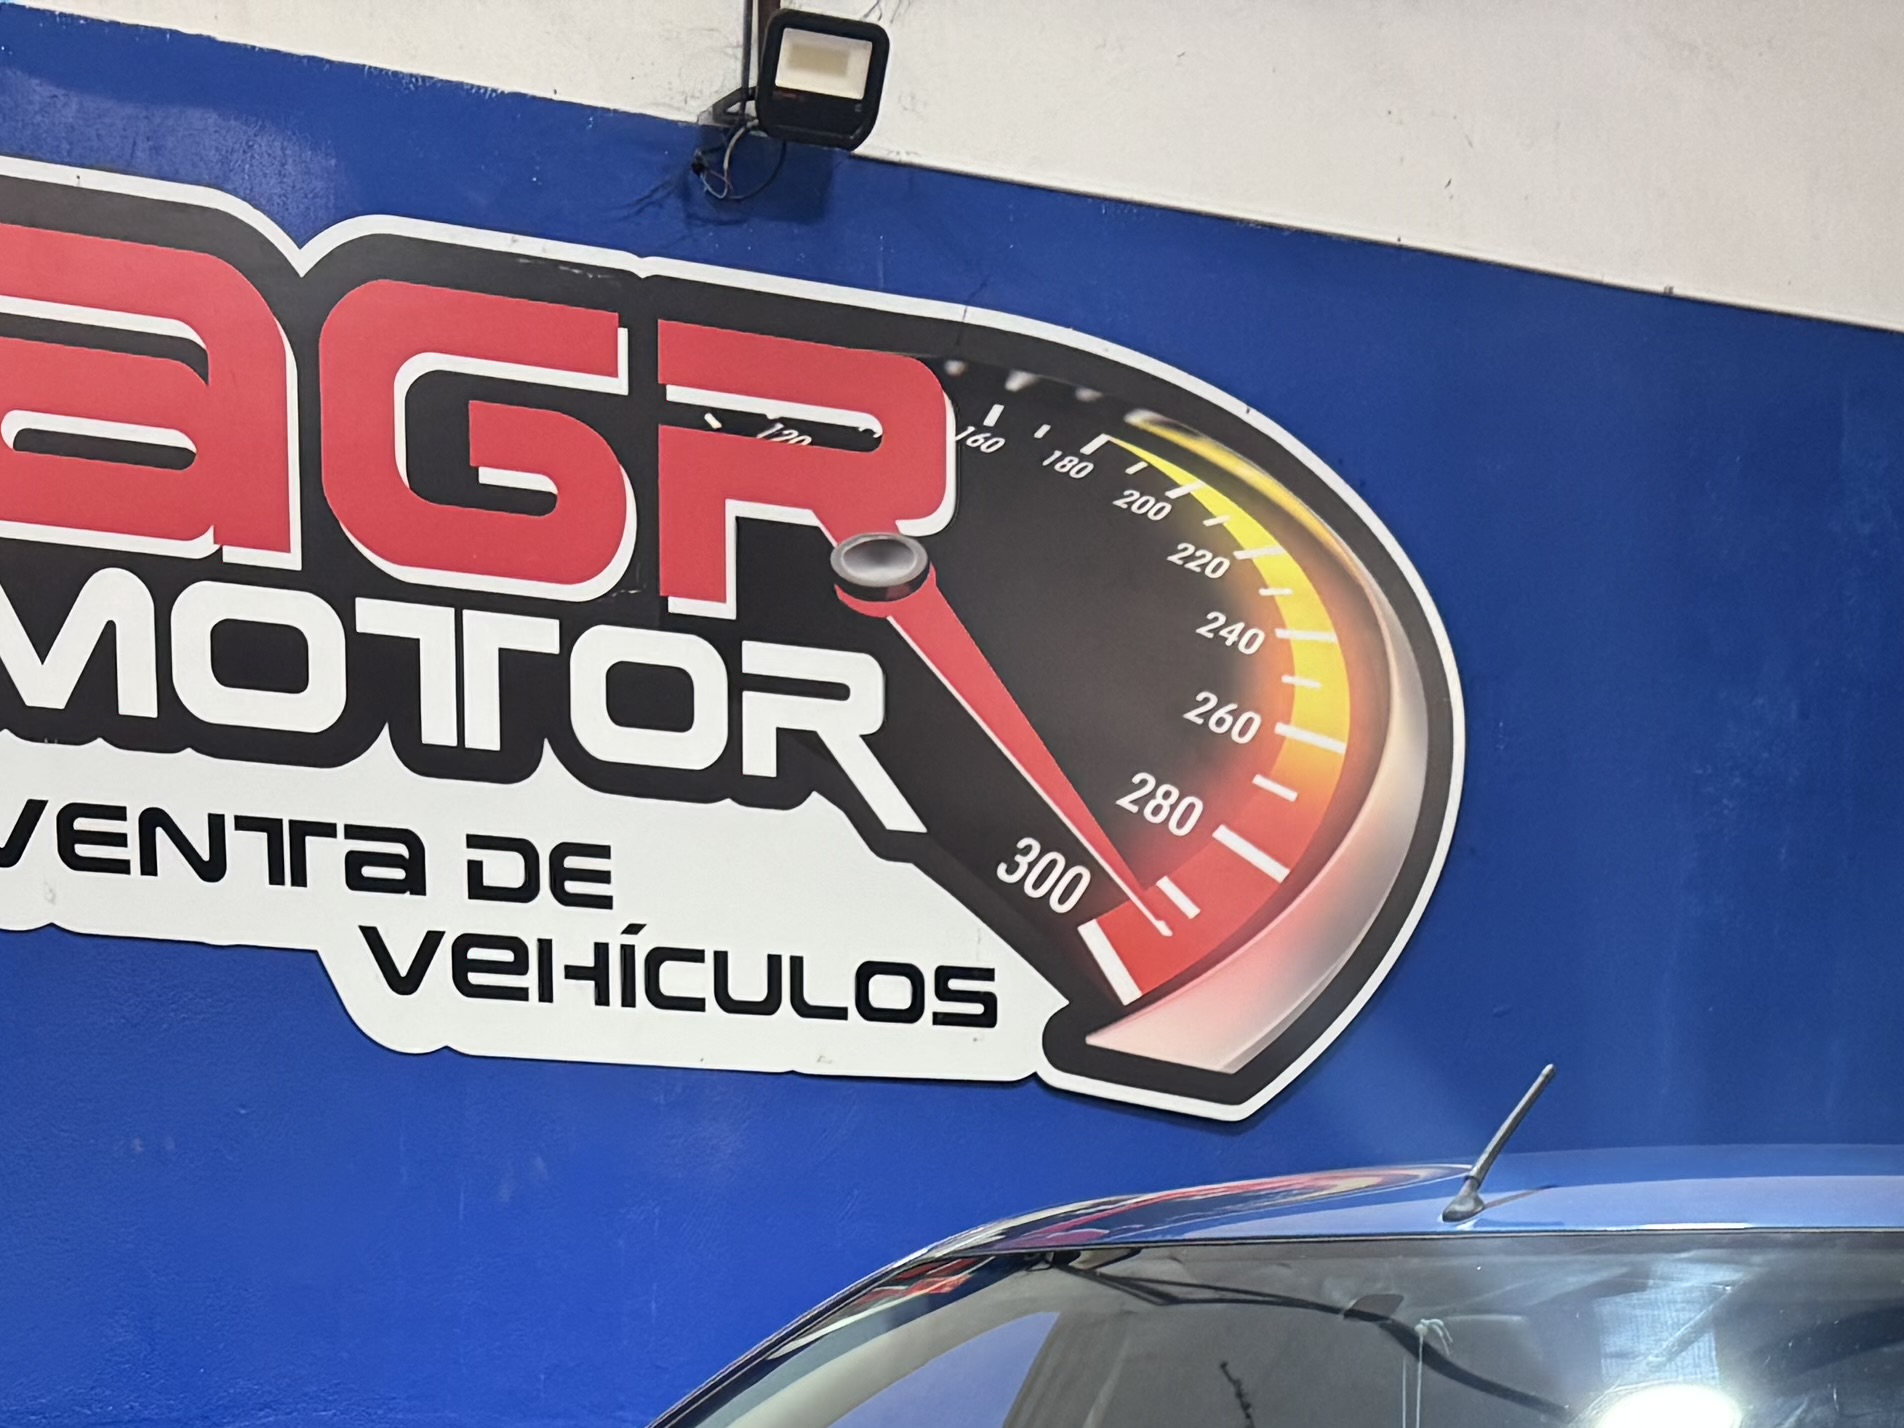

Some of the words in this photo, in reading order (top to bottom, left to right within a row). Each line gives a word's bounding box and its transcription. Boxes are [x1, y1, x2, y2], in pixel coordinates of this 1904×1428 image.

[955, 426, 1005, 453] 160
[1042, 450, 1094, 479] 180
[1112, 489, 1171, 521] 200
[1167, 543, 1230, 579] 220
[1196, 611, 1265, 655] 240
[1183, 691, 1261, 744] 260
[1116, 772, 1203, 836] 280
[467, 834, 614, 910] DE
[997, 837, 1091, 914] 300
